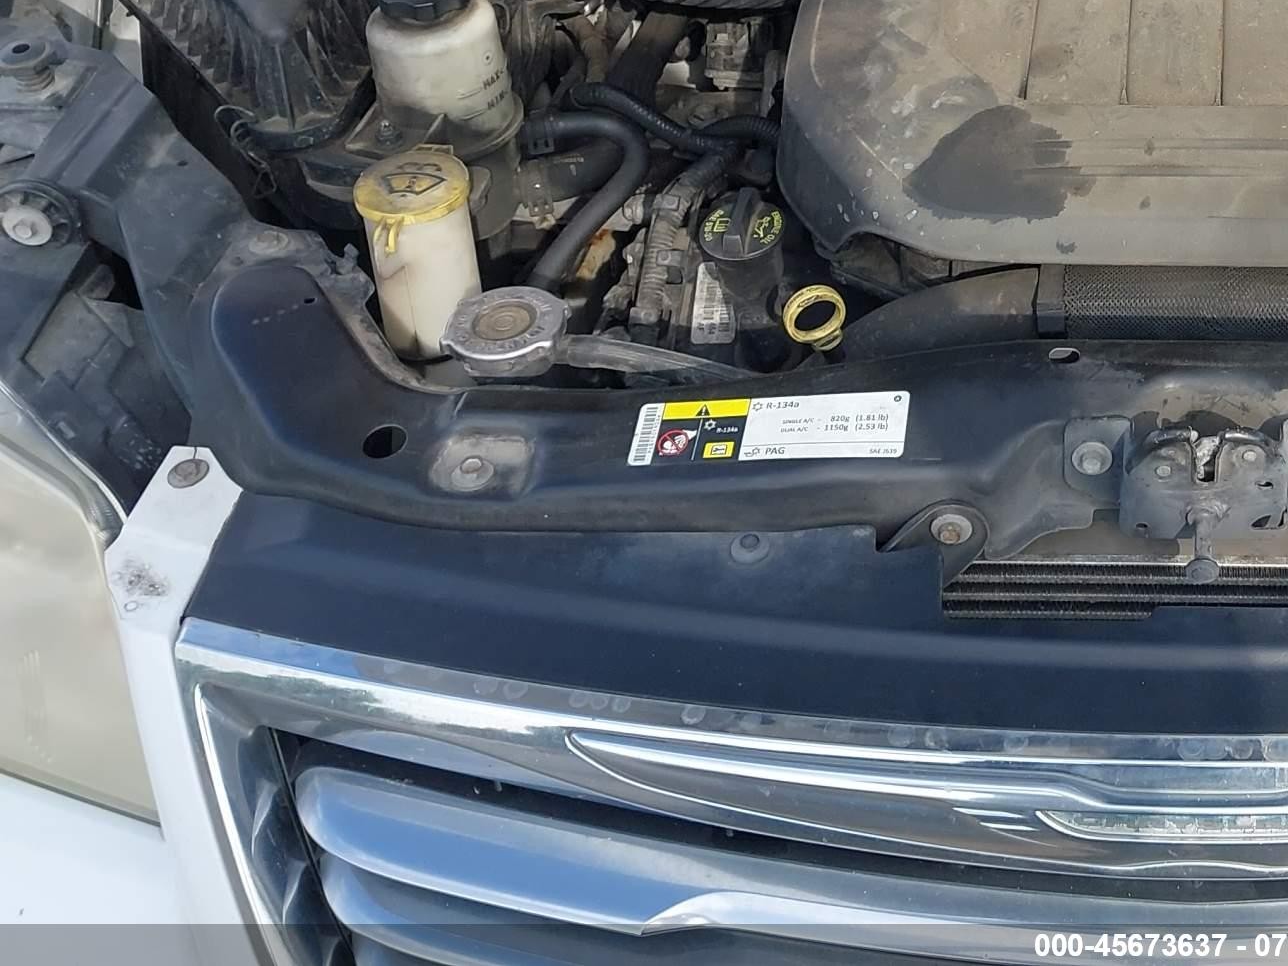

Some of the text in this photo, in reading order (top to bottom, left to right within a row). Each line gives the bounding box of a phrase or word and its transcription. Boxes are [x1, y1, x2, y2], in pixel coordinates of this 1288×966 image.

[760, 234, 775, 244] OIL
[765, 401, 800, 409] R-134a
[830, 415, 850, 423] 820g
[855, 414, 876, 423] (1.81
[878, 413, 889, 423] lb)
[715, 426, 739, 434] R-134a
[824, 424, 849, 432] 1150g
[854, 423, 876, 432] (2.53
[877, 422, 889, 432] lb)
[765, 446, 786, 455] PAG
